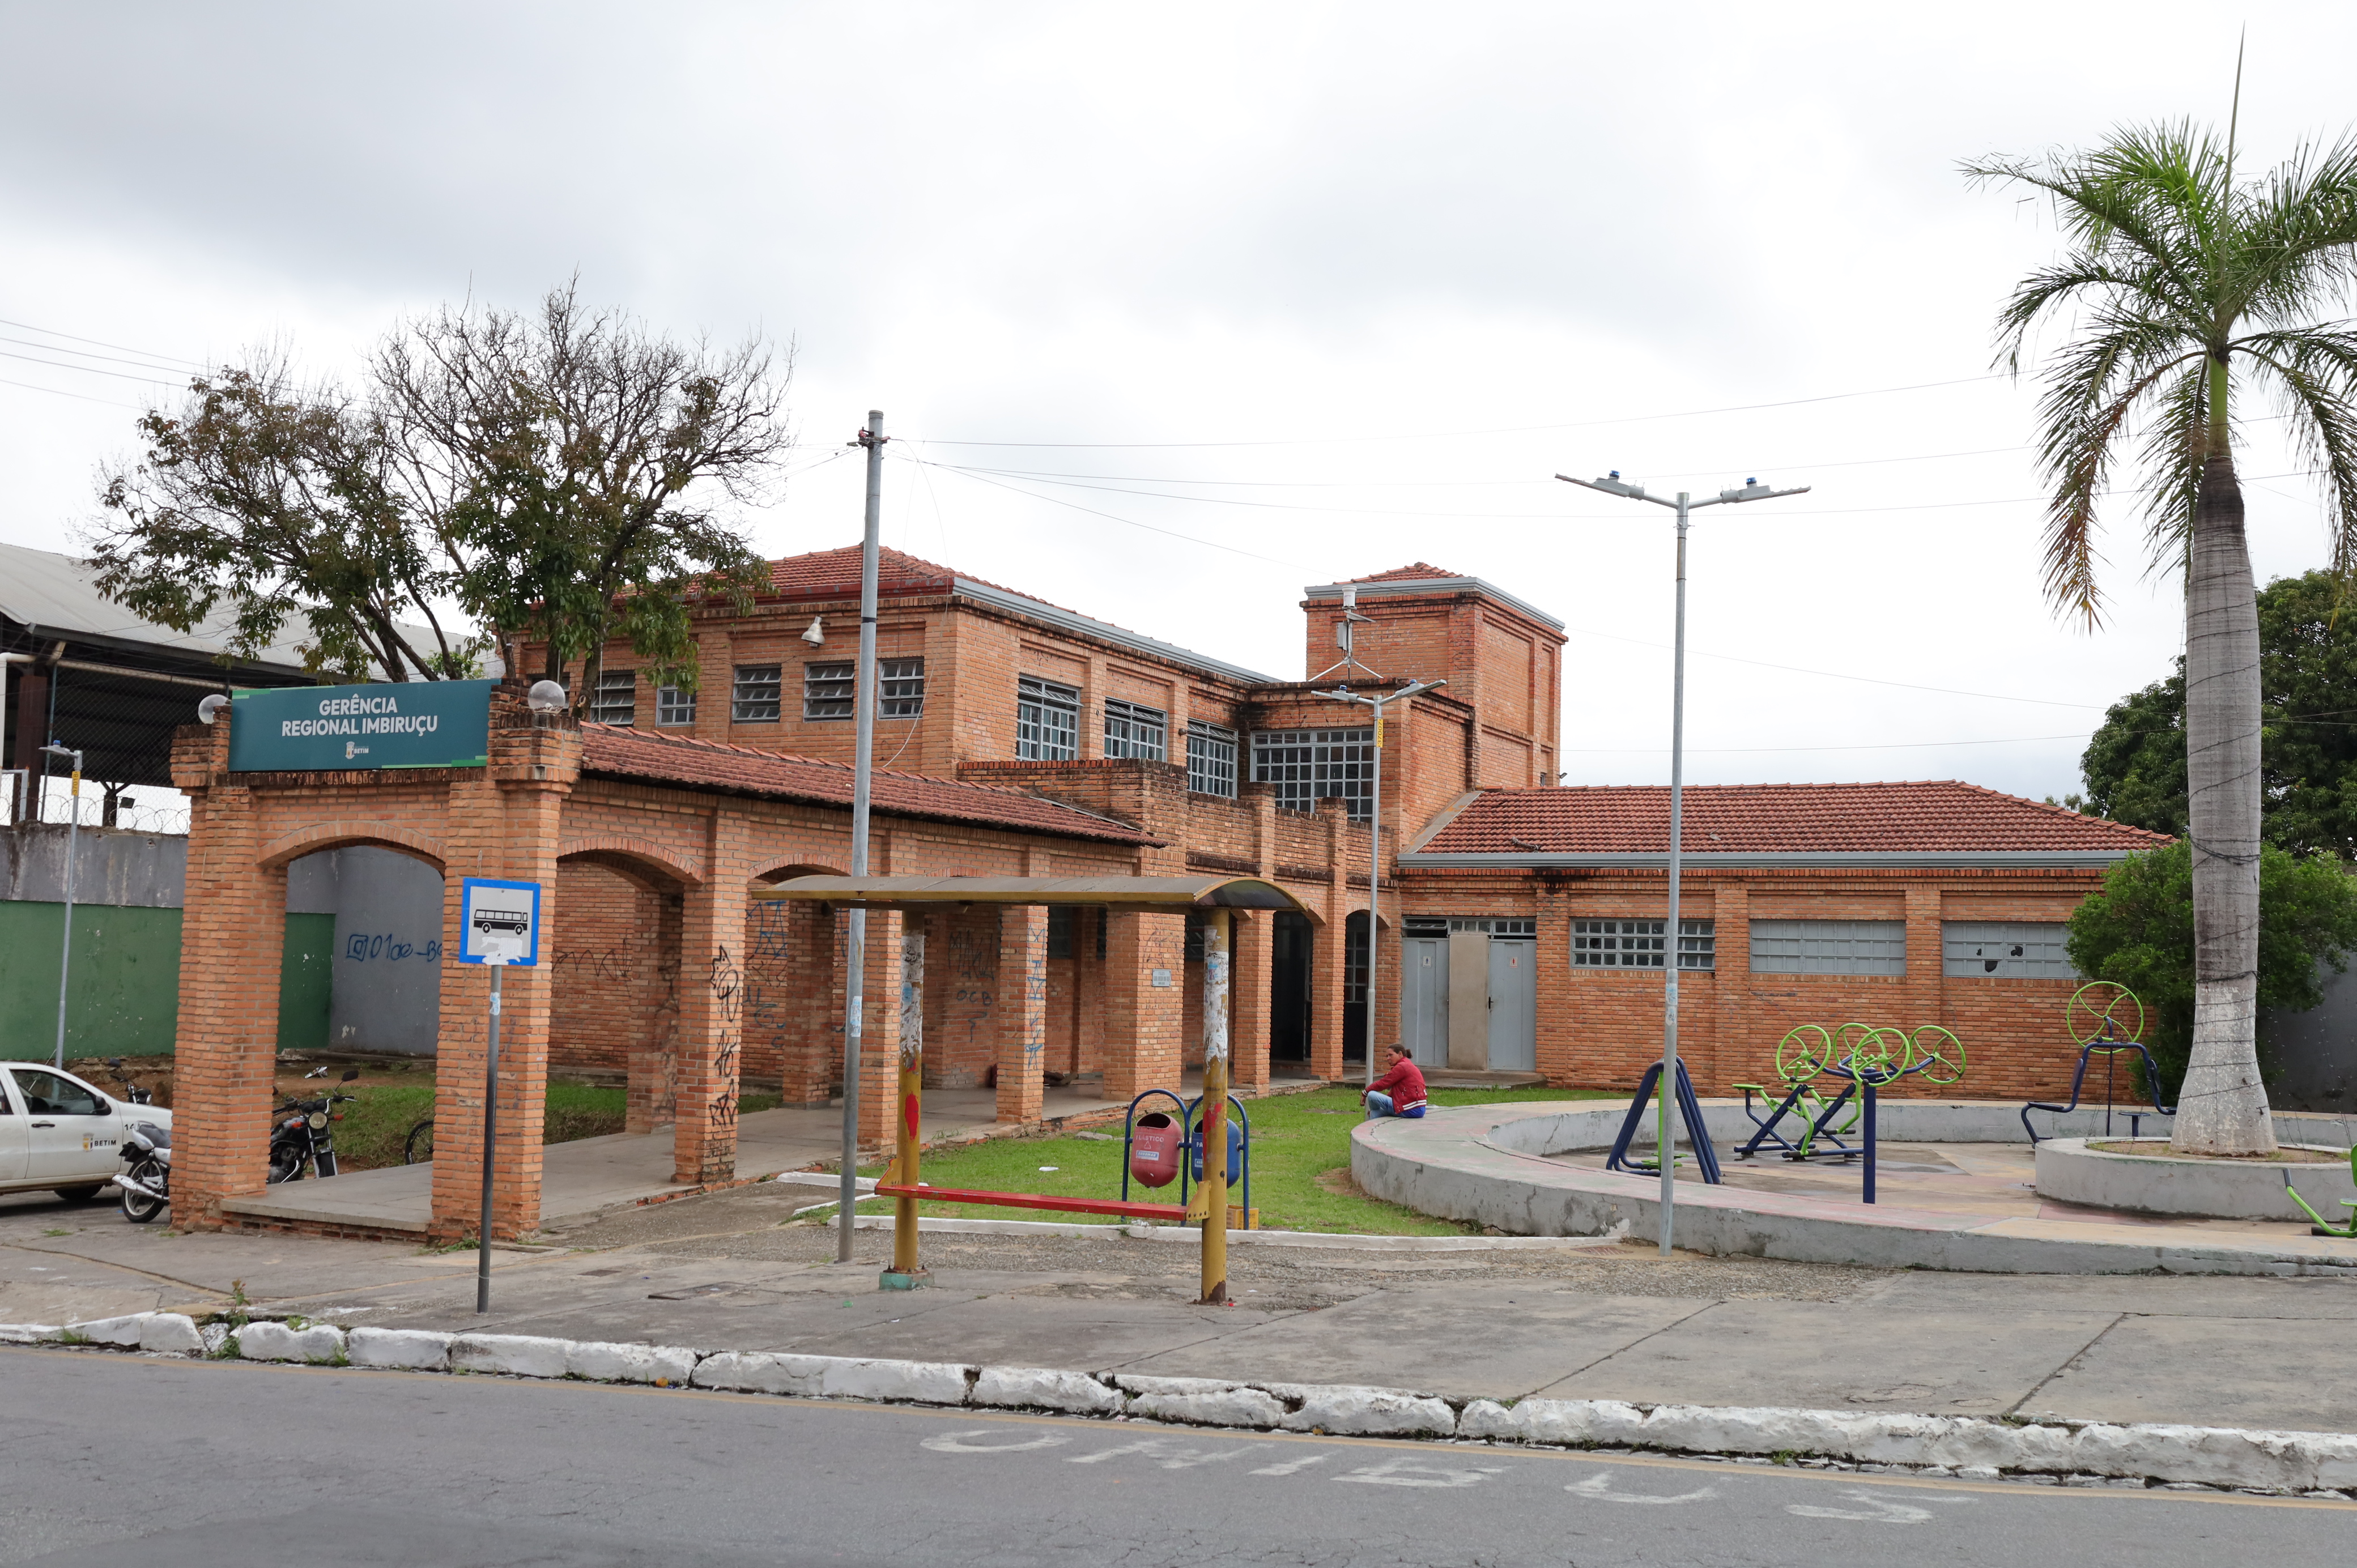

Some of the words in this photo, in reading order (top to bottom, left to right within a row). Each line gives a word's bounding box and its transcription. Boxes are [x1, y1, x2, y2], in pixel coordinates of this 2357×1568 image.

[319, 693, 398, 716] GERÊNCIA
[282, 718, 359, 737] REGIONAL
[361, 715, 438, 737] IMBIRUÇU
